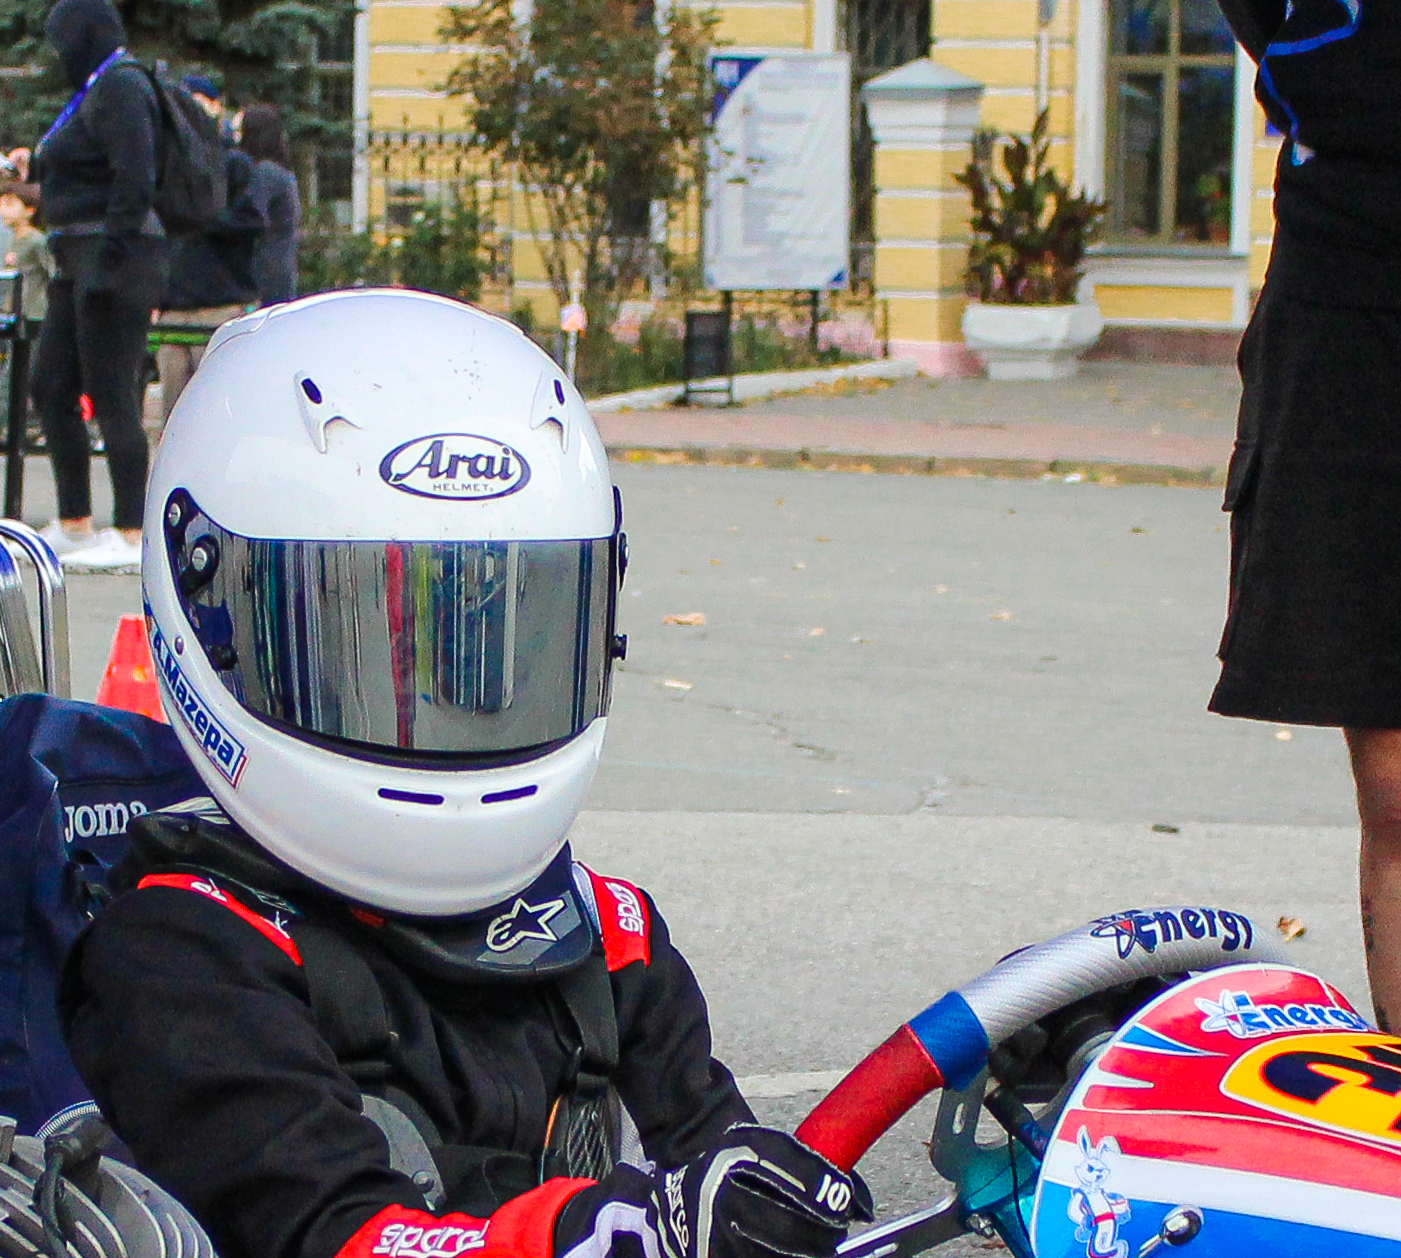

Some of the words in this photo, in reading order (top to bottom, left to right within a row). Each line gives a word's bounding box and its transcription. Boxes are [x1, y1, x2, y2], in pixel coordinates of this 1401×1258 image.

[391, 440, 516, 482] Arai
[433, 483, 489, 492] HELMET
[1113, 908, 1254, 955] Energy
